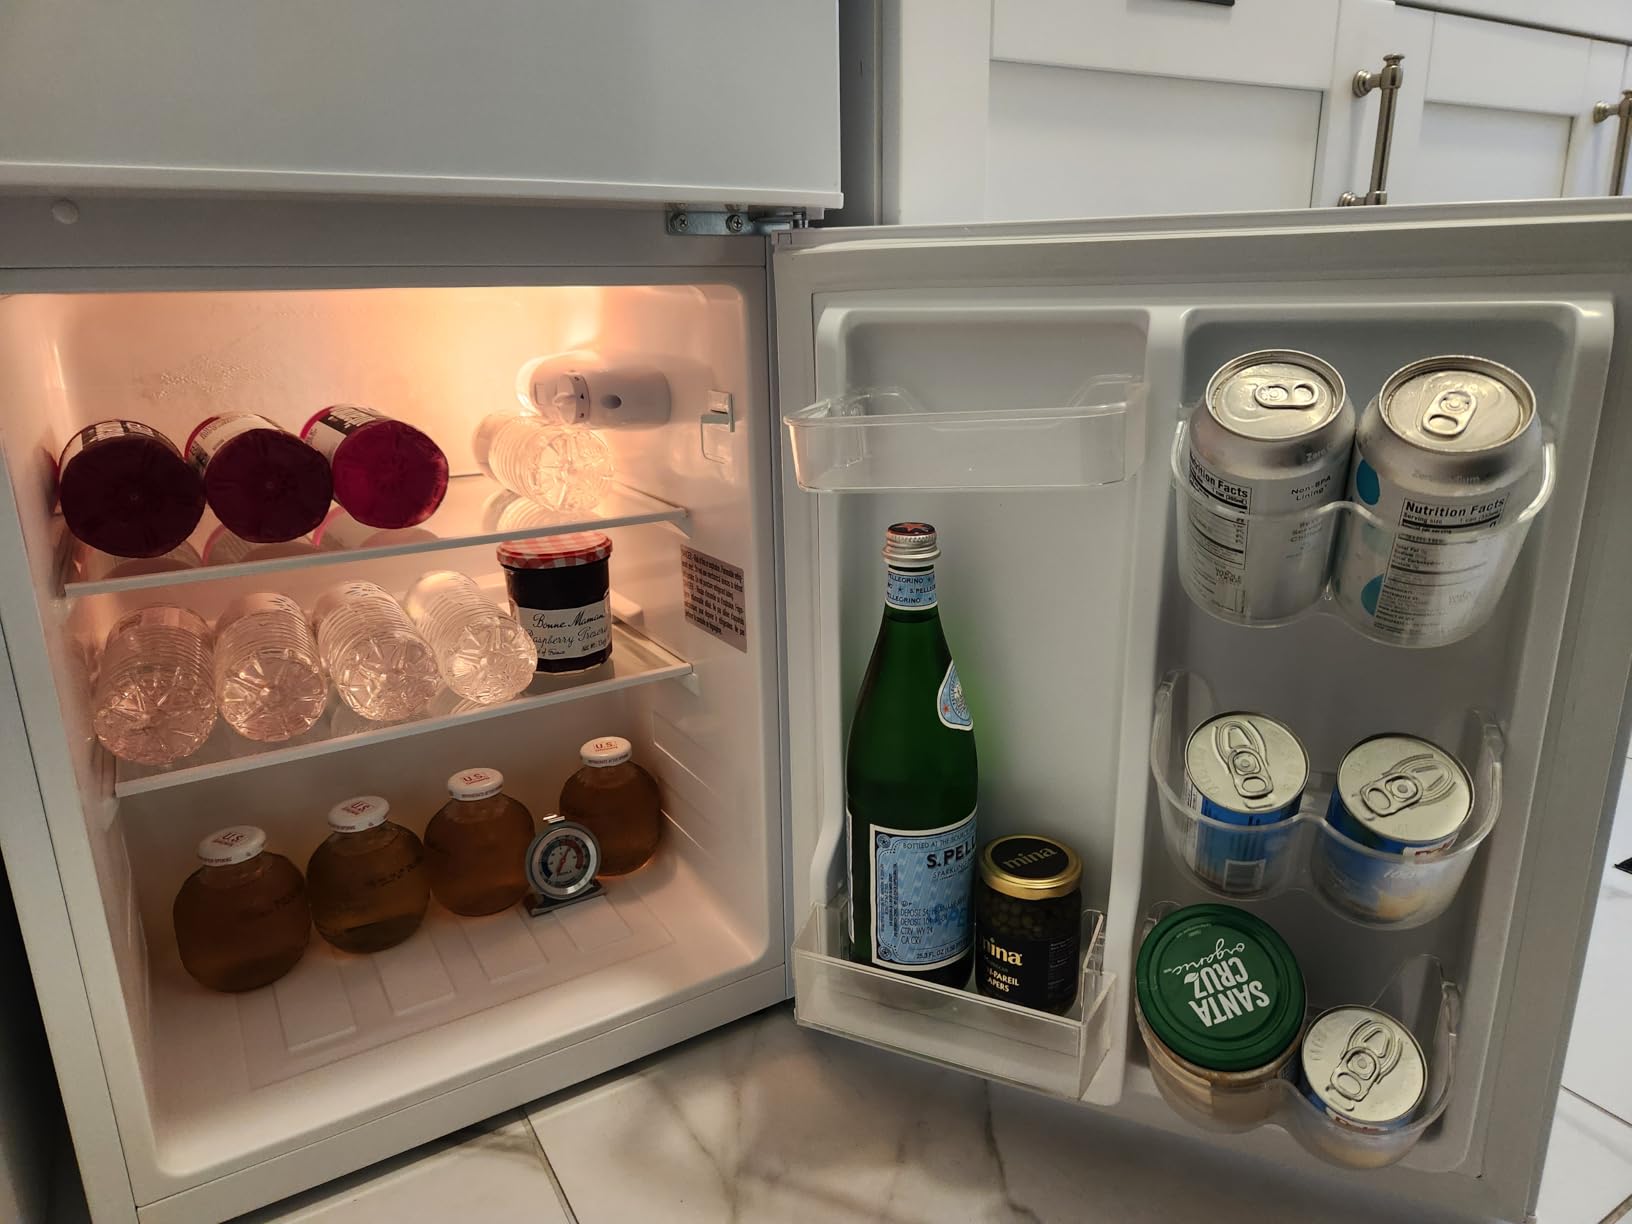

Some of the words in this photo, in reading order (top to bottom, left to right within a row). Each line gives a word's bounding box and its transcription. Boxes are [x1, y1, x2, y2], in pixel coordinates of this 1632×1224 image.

[1218, 479, 1248, 498] Facts
[1291, 475, 1331, 495] Non-BPA
[1405, 501, 1466, 517] Nutrition
[1471, 498, 1505, 516] Facts
[1403, 512, 1428, 524] Serving
[532, 612, 567, 629] Bonne
[568, 610, 605, 627] Maman
[903, 842, 930, 850] BOTTLED
[926, 835, 977, 869] S.PELL
[1002, 847, 1058, 870] mina
[1171, 938, 1245, 975] organic
[987, 977, 1010, 993] APERS
[1194, 957, 1249, 999] CRUZ
[1188, 980, 1270, 1028] SANTA
